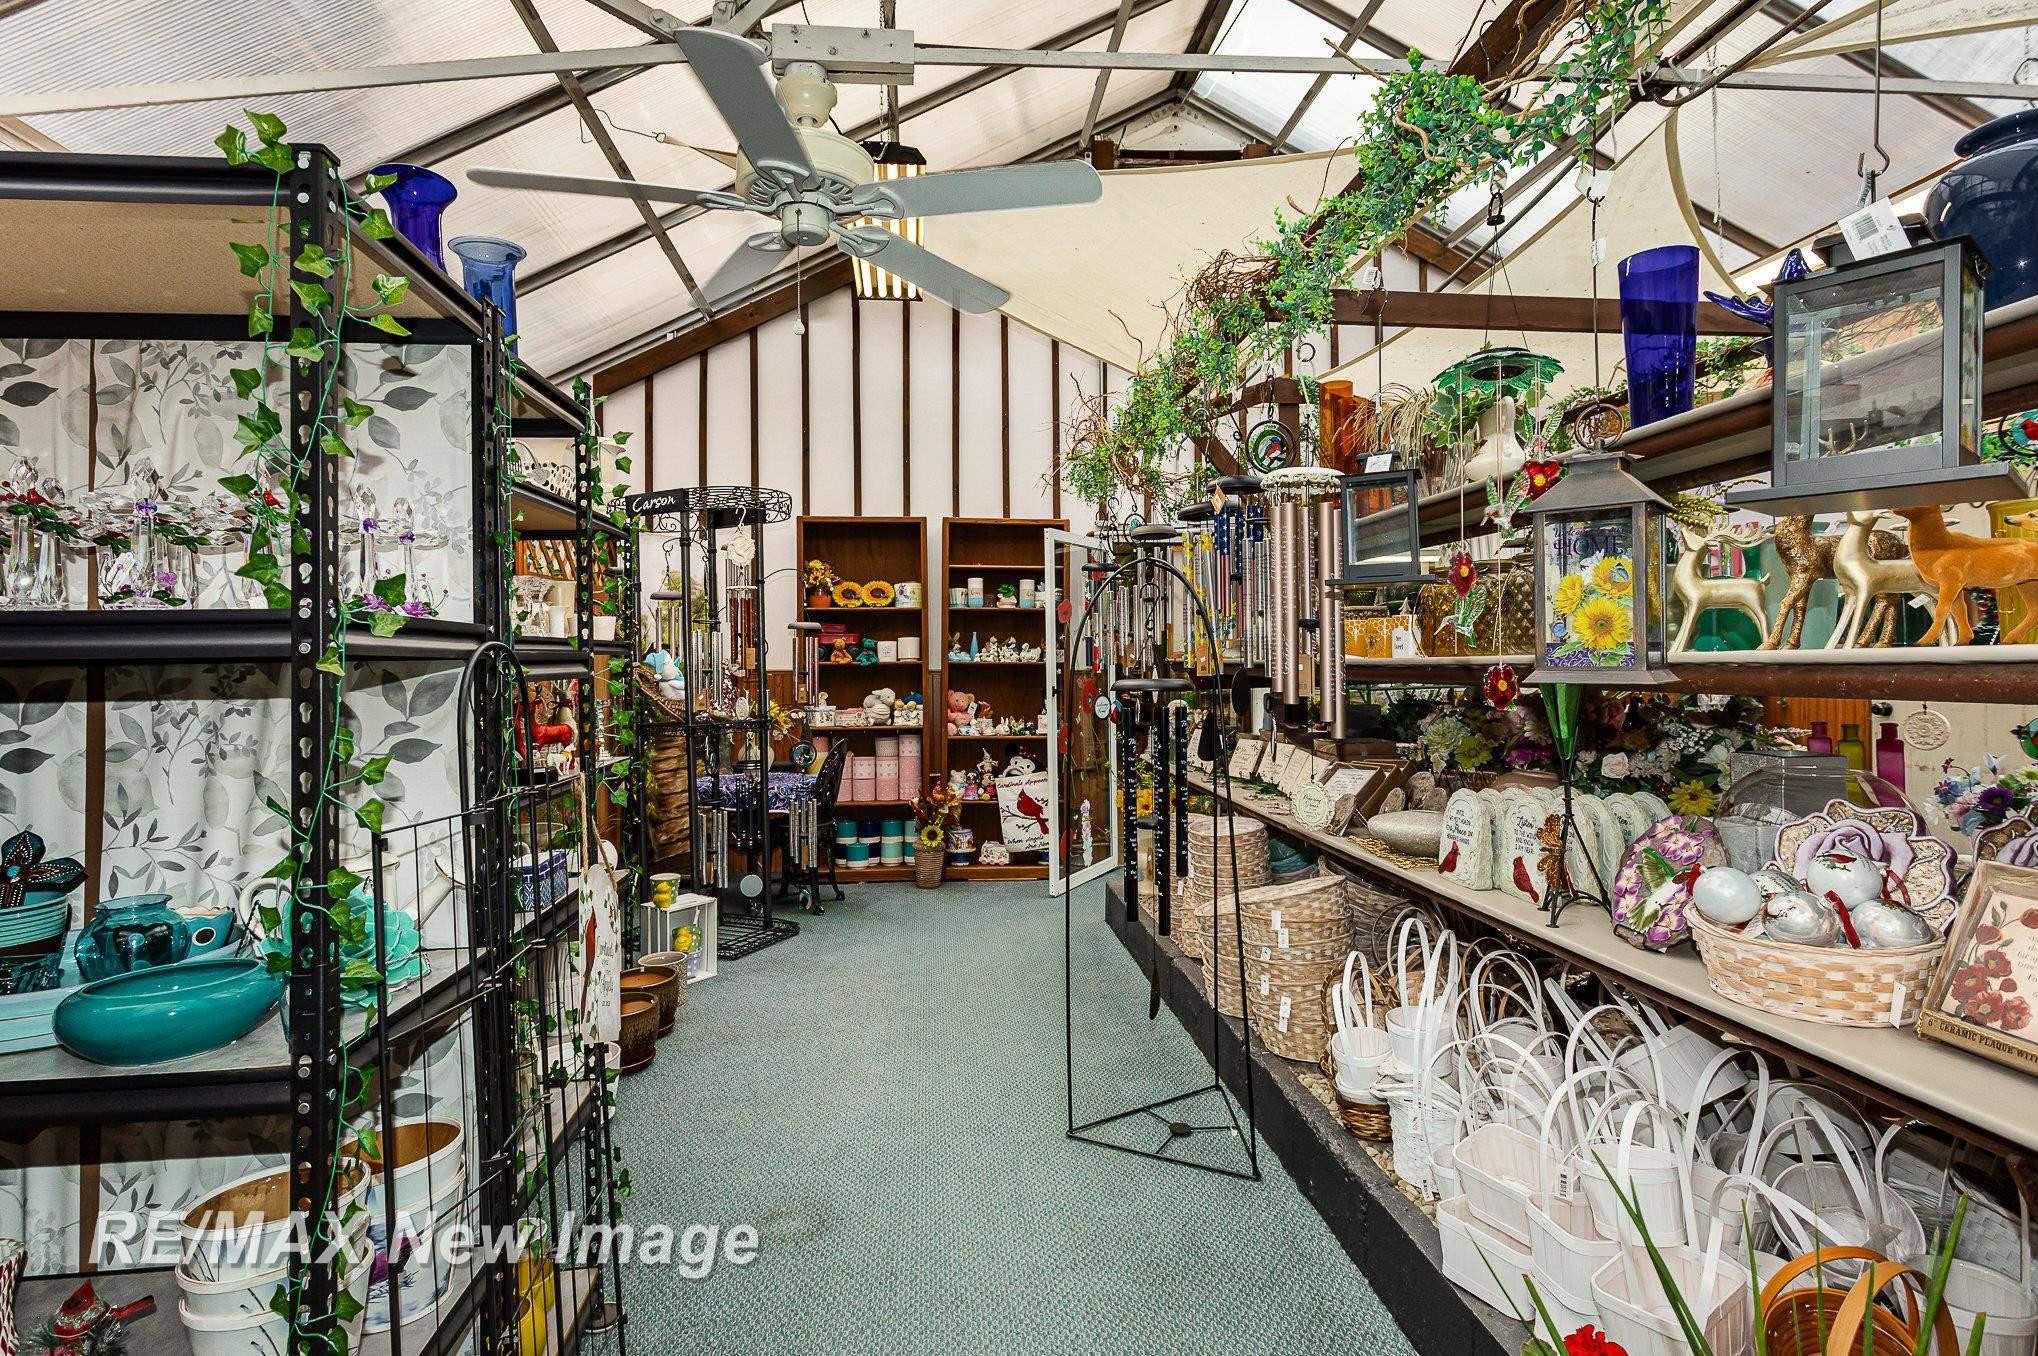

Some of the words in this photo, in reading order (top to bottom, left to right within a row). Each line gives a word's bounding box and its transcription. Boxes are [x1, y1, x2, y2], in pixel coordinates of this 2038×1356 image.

[632, 495, 676, 513] Carson
[1553, 534, 1624, 557] HOME
[1939, 1021, 1978, 1042] CERAMIC
[1979, 1034, 2014, 1055] PLAQUE
